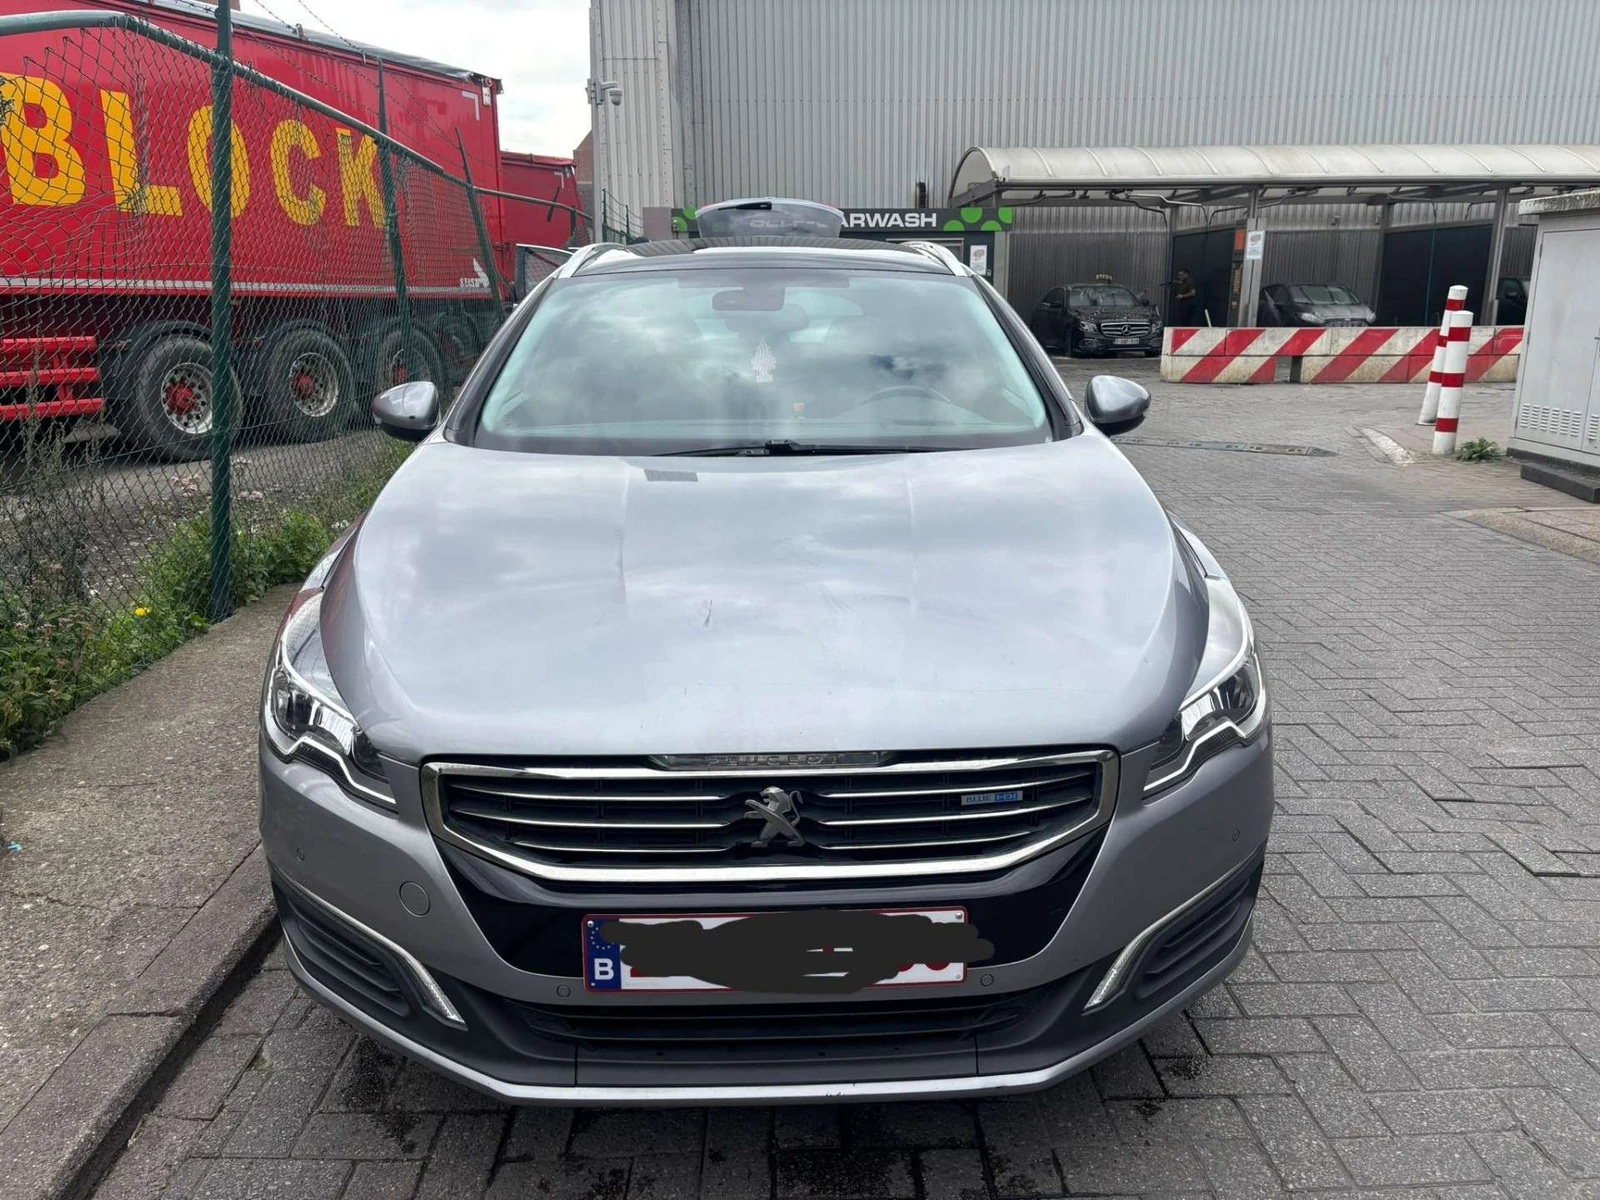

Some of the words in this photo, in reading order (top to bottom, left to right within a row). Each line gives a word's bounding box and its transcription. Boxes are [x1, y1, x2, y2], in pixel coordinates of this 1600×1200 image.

[0, 72, 386, 228] BLOCK
[838, 212, 937, 228] ARWASH
[706, 754, 842, 767] PEUGEOT
[594, 958, 614, 980] B
